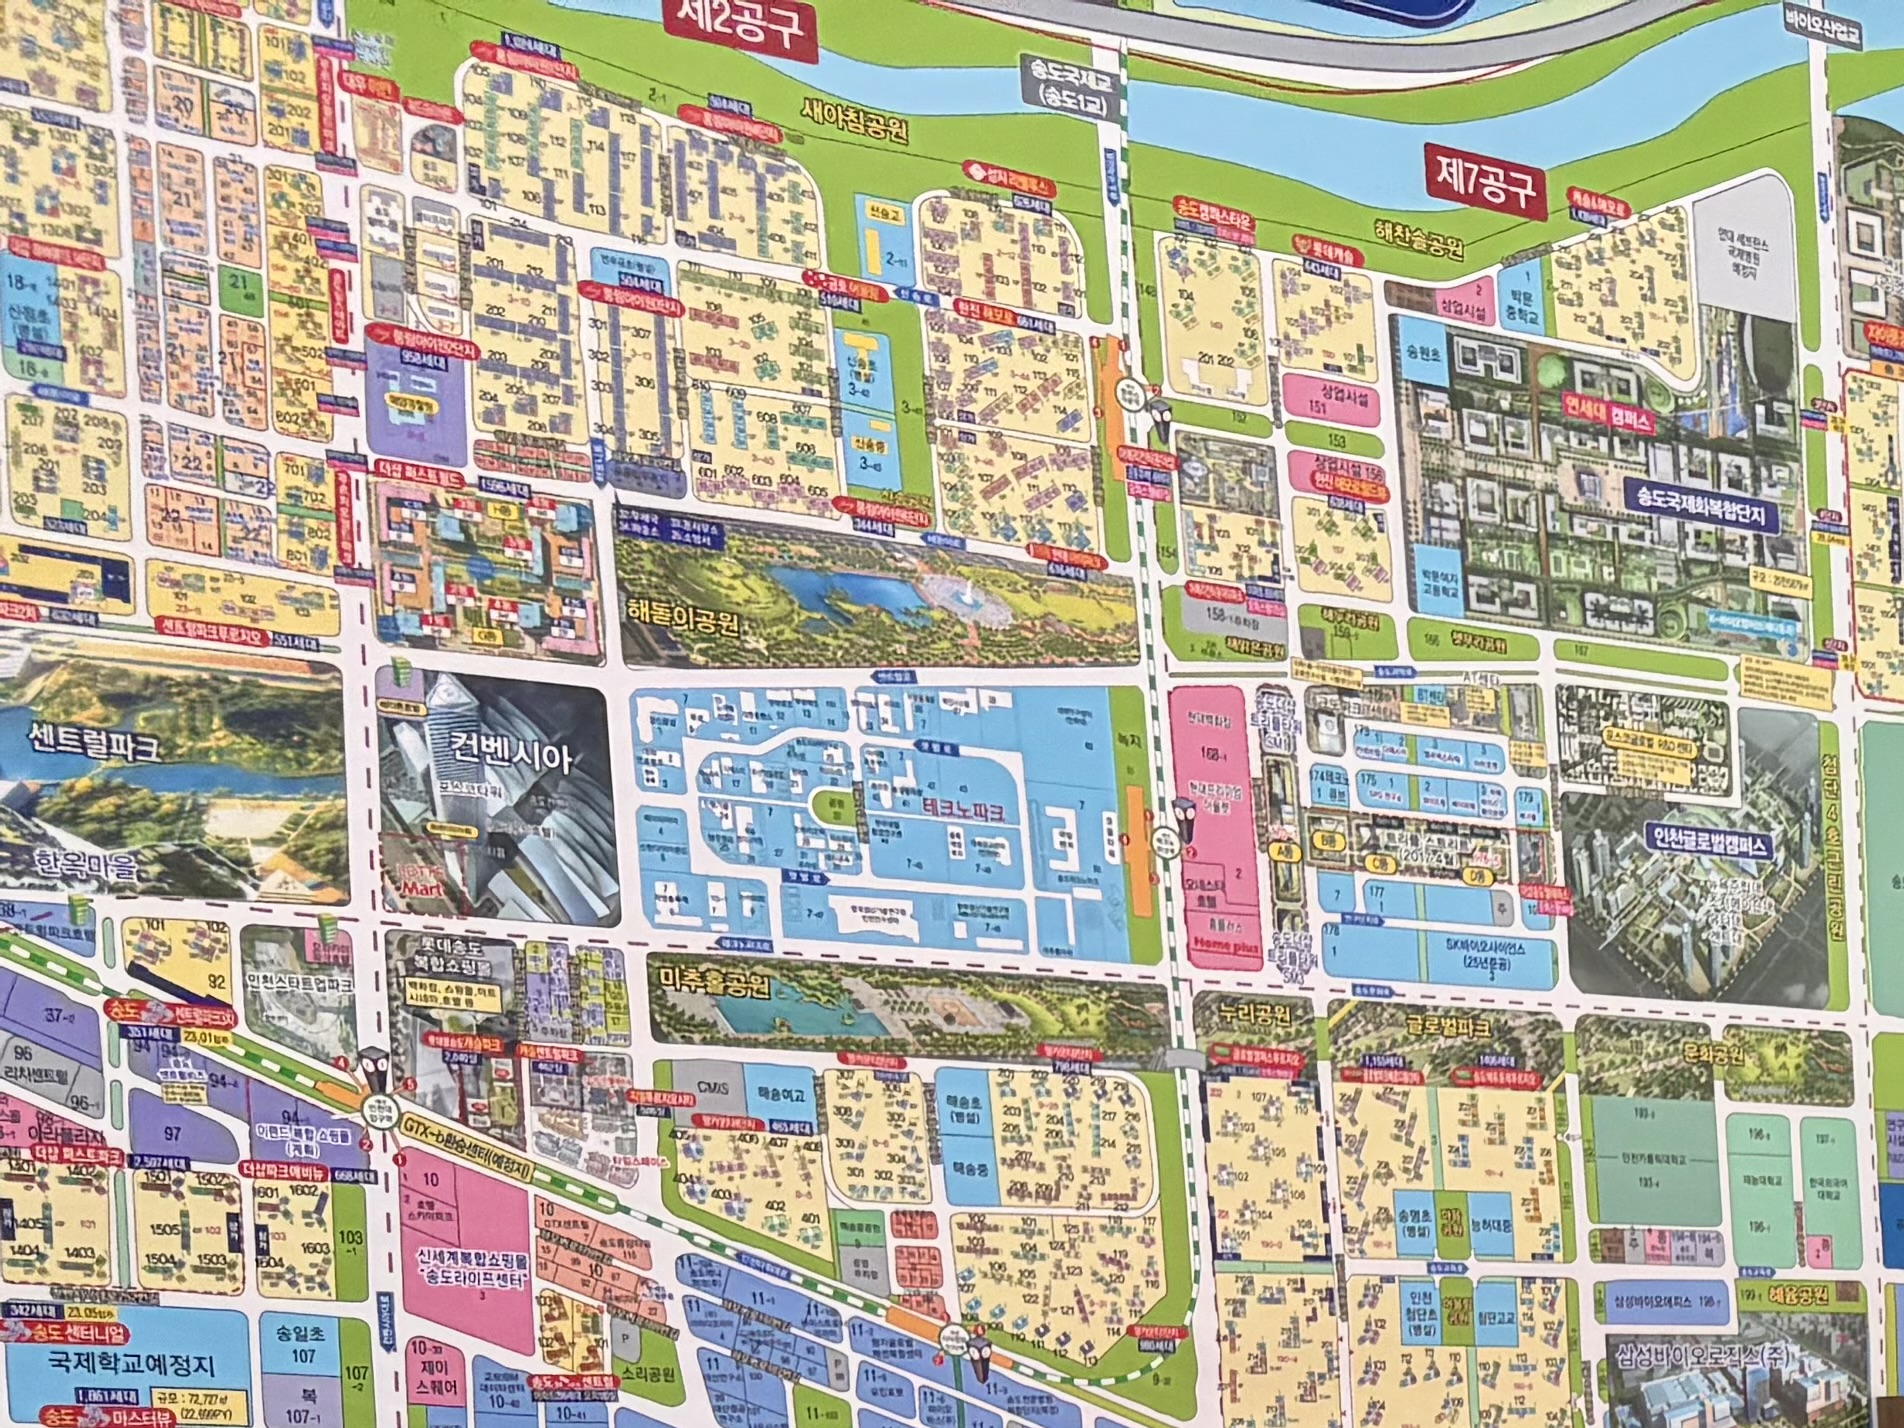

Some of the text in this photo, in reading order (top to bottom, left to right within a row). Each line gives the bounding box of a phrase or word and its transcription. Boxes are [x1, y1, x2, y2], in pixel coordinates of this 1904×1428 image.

[678, 0, 806, 48] 제2공구
[1786, 10, 1859, 48] 바이오산업교
[1031, 61, 1114, 93] 송도국제교
[1040, 84, 1106, 117] (송도1교)
[802, 98, 909, 145] 새아침공원
[1438, 154, 1537, 211] 제7공구
[1376, 219, 1465, 262] 해찬솔공원
[1441, 299, 1487, 322] 상업시설
[1322, 385, 1369, 407] 상업시설
[1566, 395, 1652, 431] 연세대 캠퍼스
[1638, 486, 1767, 527] 송도국제화복합단지
[626, 599, 739, 637] 해돋이공원
[29, 722, 163, 764] 센트럴파크
[450, 730, 573, 776] 컨벤시아
[922, 797, 1006, 823] 테크노파크
[1653, 828, 1768, 858] 인천글로벌캠퍼스
[37, 850, 138, 877] 한옥마을
[658, 966, 771, 999] 미추홀공원
[1219, 1002, 1293, 1028] 누리공원
[1406, 1014, 1491, 1040] 글로벌파크
[1684, 1043, 1744, 1067] 문화공원
[163, 1126, 181, 1142] 97
[416, 1248, 530, 1271] 신세계복합쇼핑몰
[275, 1325, 326, 1343] 송일초
[47, 1350, 217, 1379] 국제학교예정지
[292, 1349, 316, 1365] 107
[1615, 1342, 1791, 1370] 삼성바이오로직스(주)
[345, 1365, 369, 1381] 107
[622, 1364, 676, 1383] 소리공원
